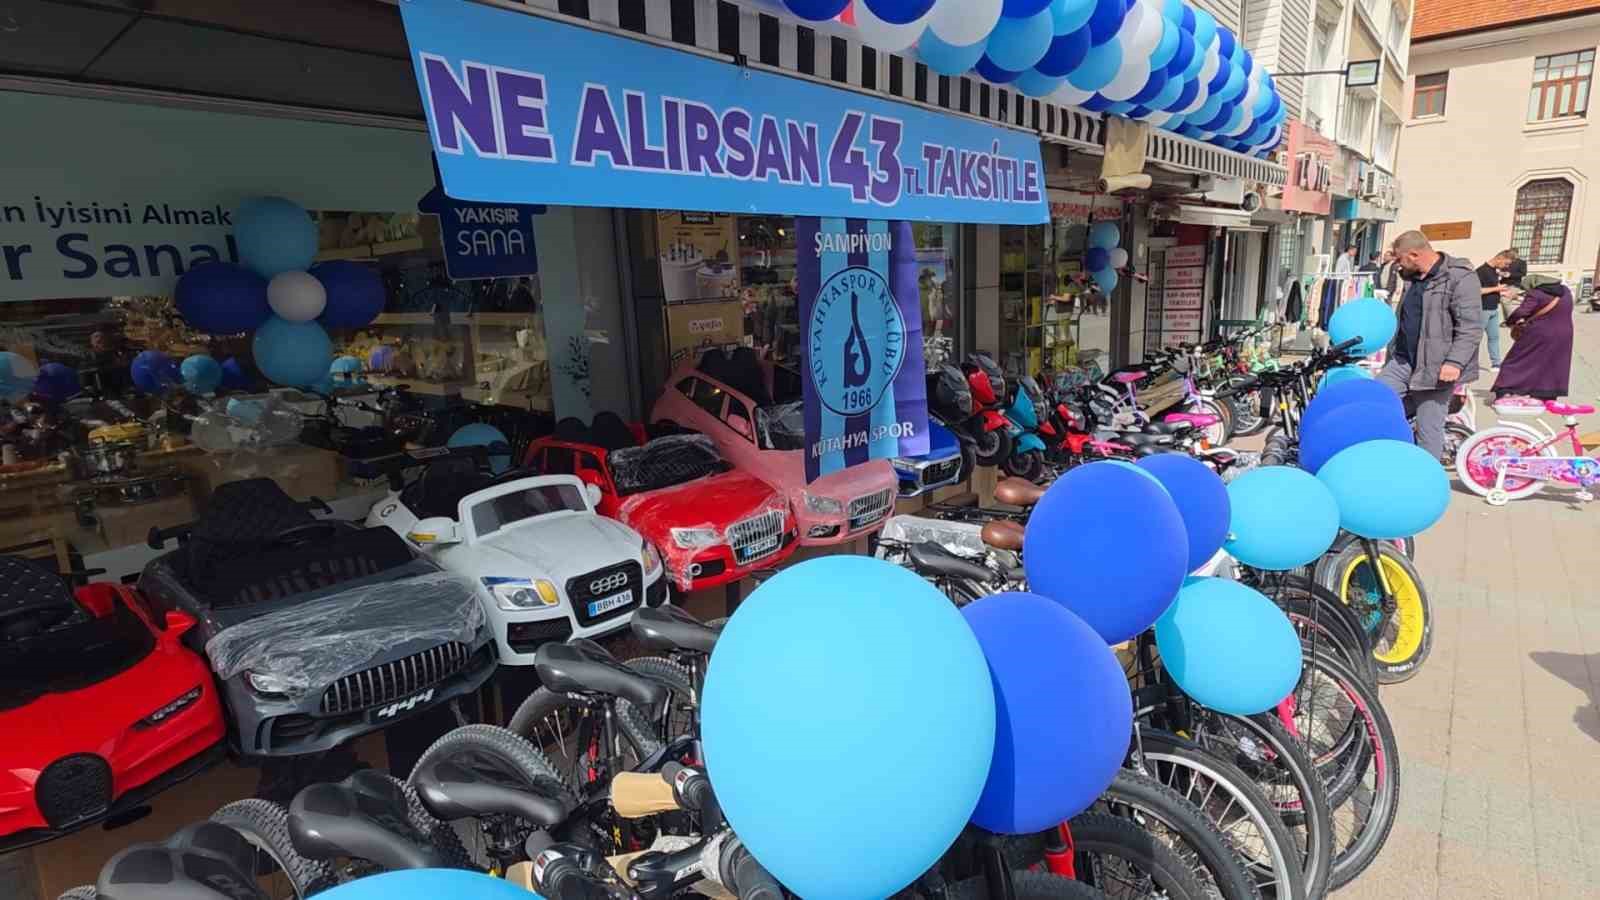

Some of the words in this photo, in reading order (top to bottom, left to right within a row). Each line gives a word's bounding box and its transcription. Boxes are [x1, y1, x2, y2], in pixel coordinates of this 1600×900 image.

[420, 51, 556, 163] NE
[571, 82, 821, 186] ALIRSAN
[828, 112, 902, 207] 43
[903, 167, 924, 196] TL
[923, 137, 1040, 202] TAKSİTLE
[0, 205, 26, 223] n
[142, 203, 233, 225] Almak
[454, 207, 520, 225] YAKIŞIR
[457, 229, 526, 256] SANA
[814, 229, 892, 258] ŞAMPİYON
[842, 387, 872, 409] 1966
[871, 422, 914, 442] SPOR
